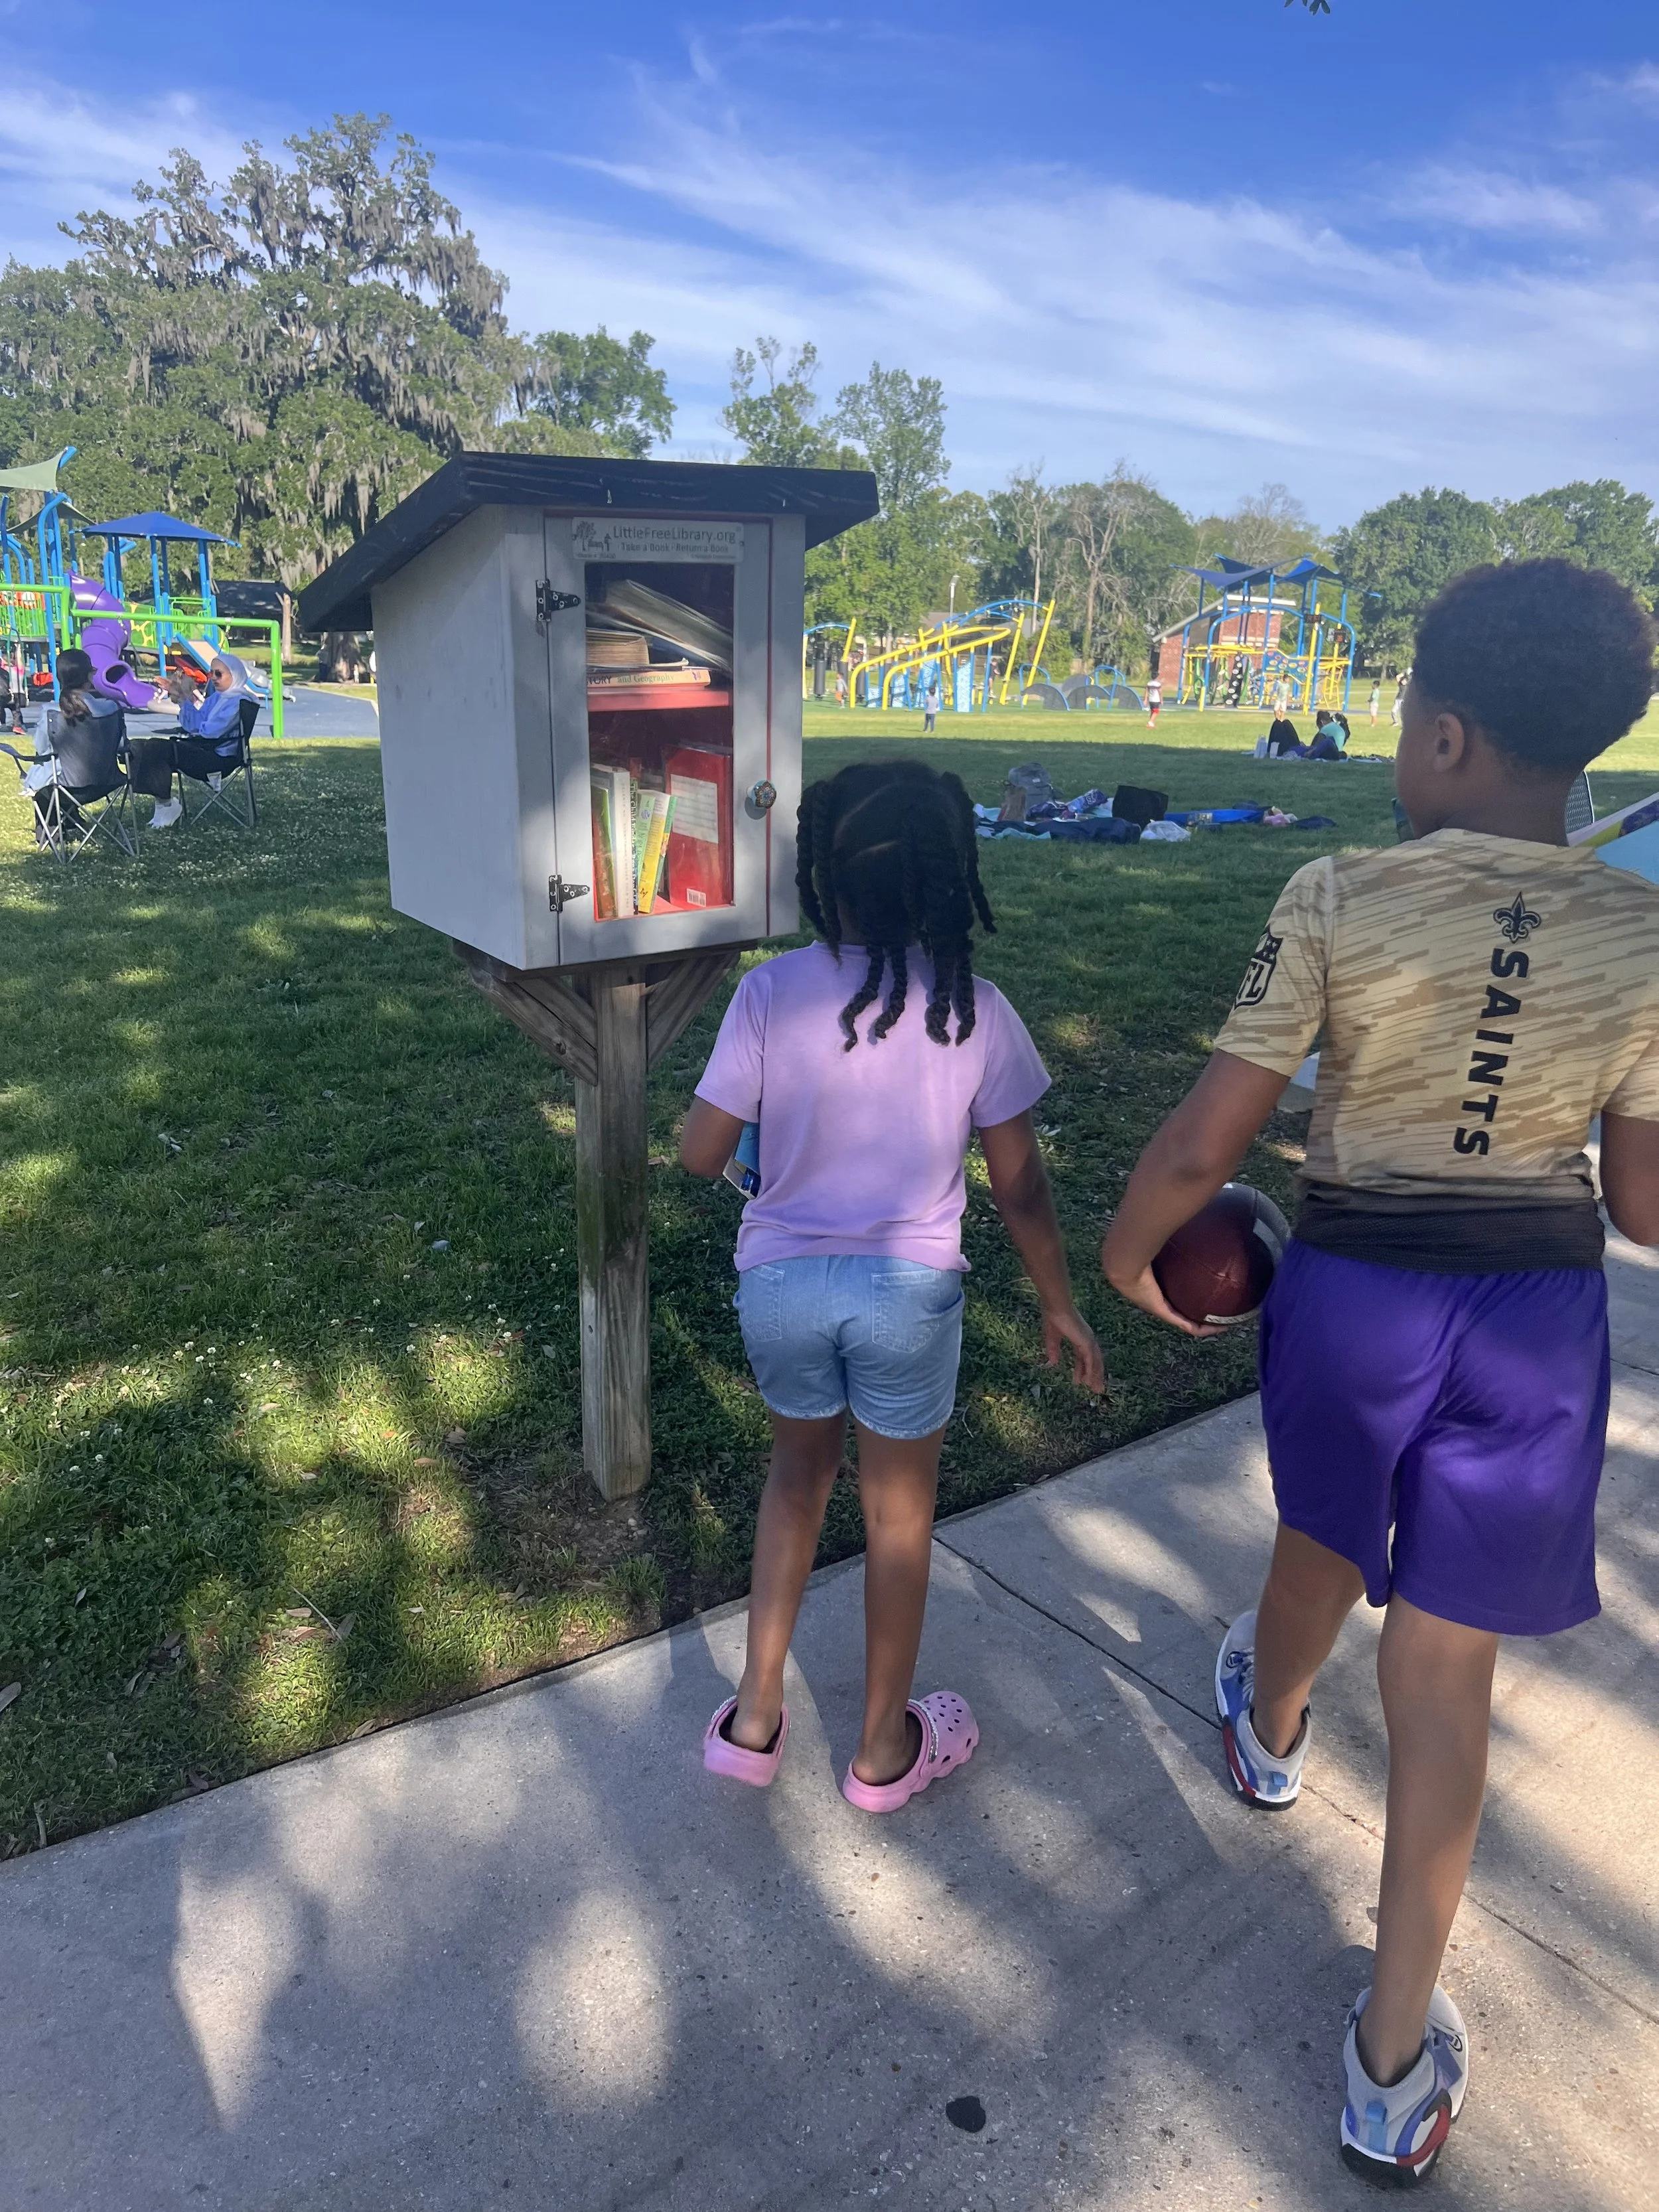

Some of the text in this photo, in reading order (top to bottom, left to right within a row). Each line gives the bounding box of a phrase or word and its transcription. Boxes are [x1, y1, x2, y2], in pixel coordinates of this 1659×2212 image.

[613, 526, 736, 544] LittleFreeLibrary.org
[620, 542, 640, 552] Take
[634, 673, 674, 683] Geography
[1453, 948, 1529, 1155] SAINTS
